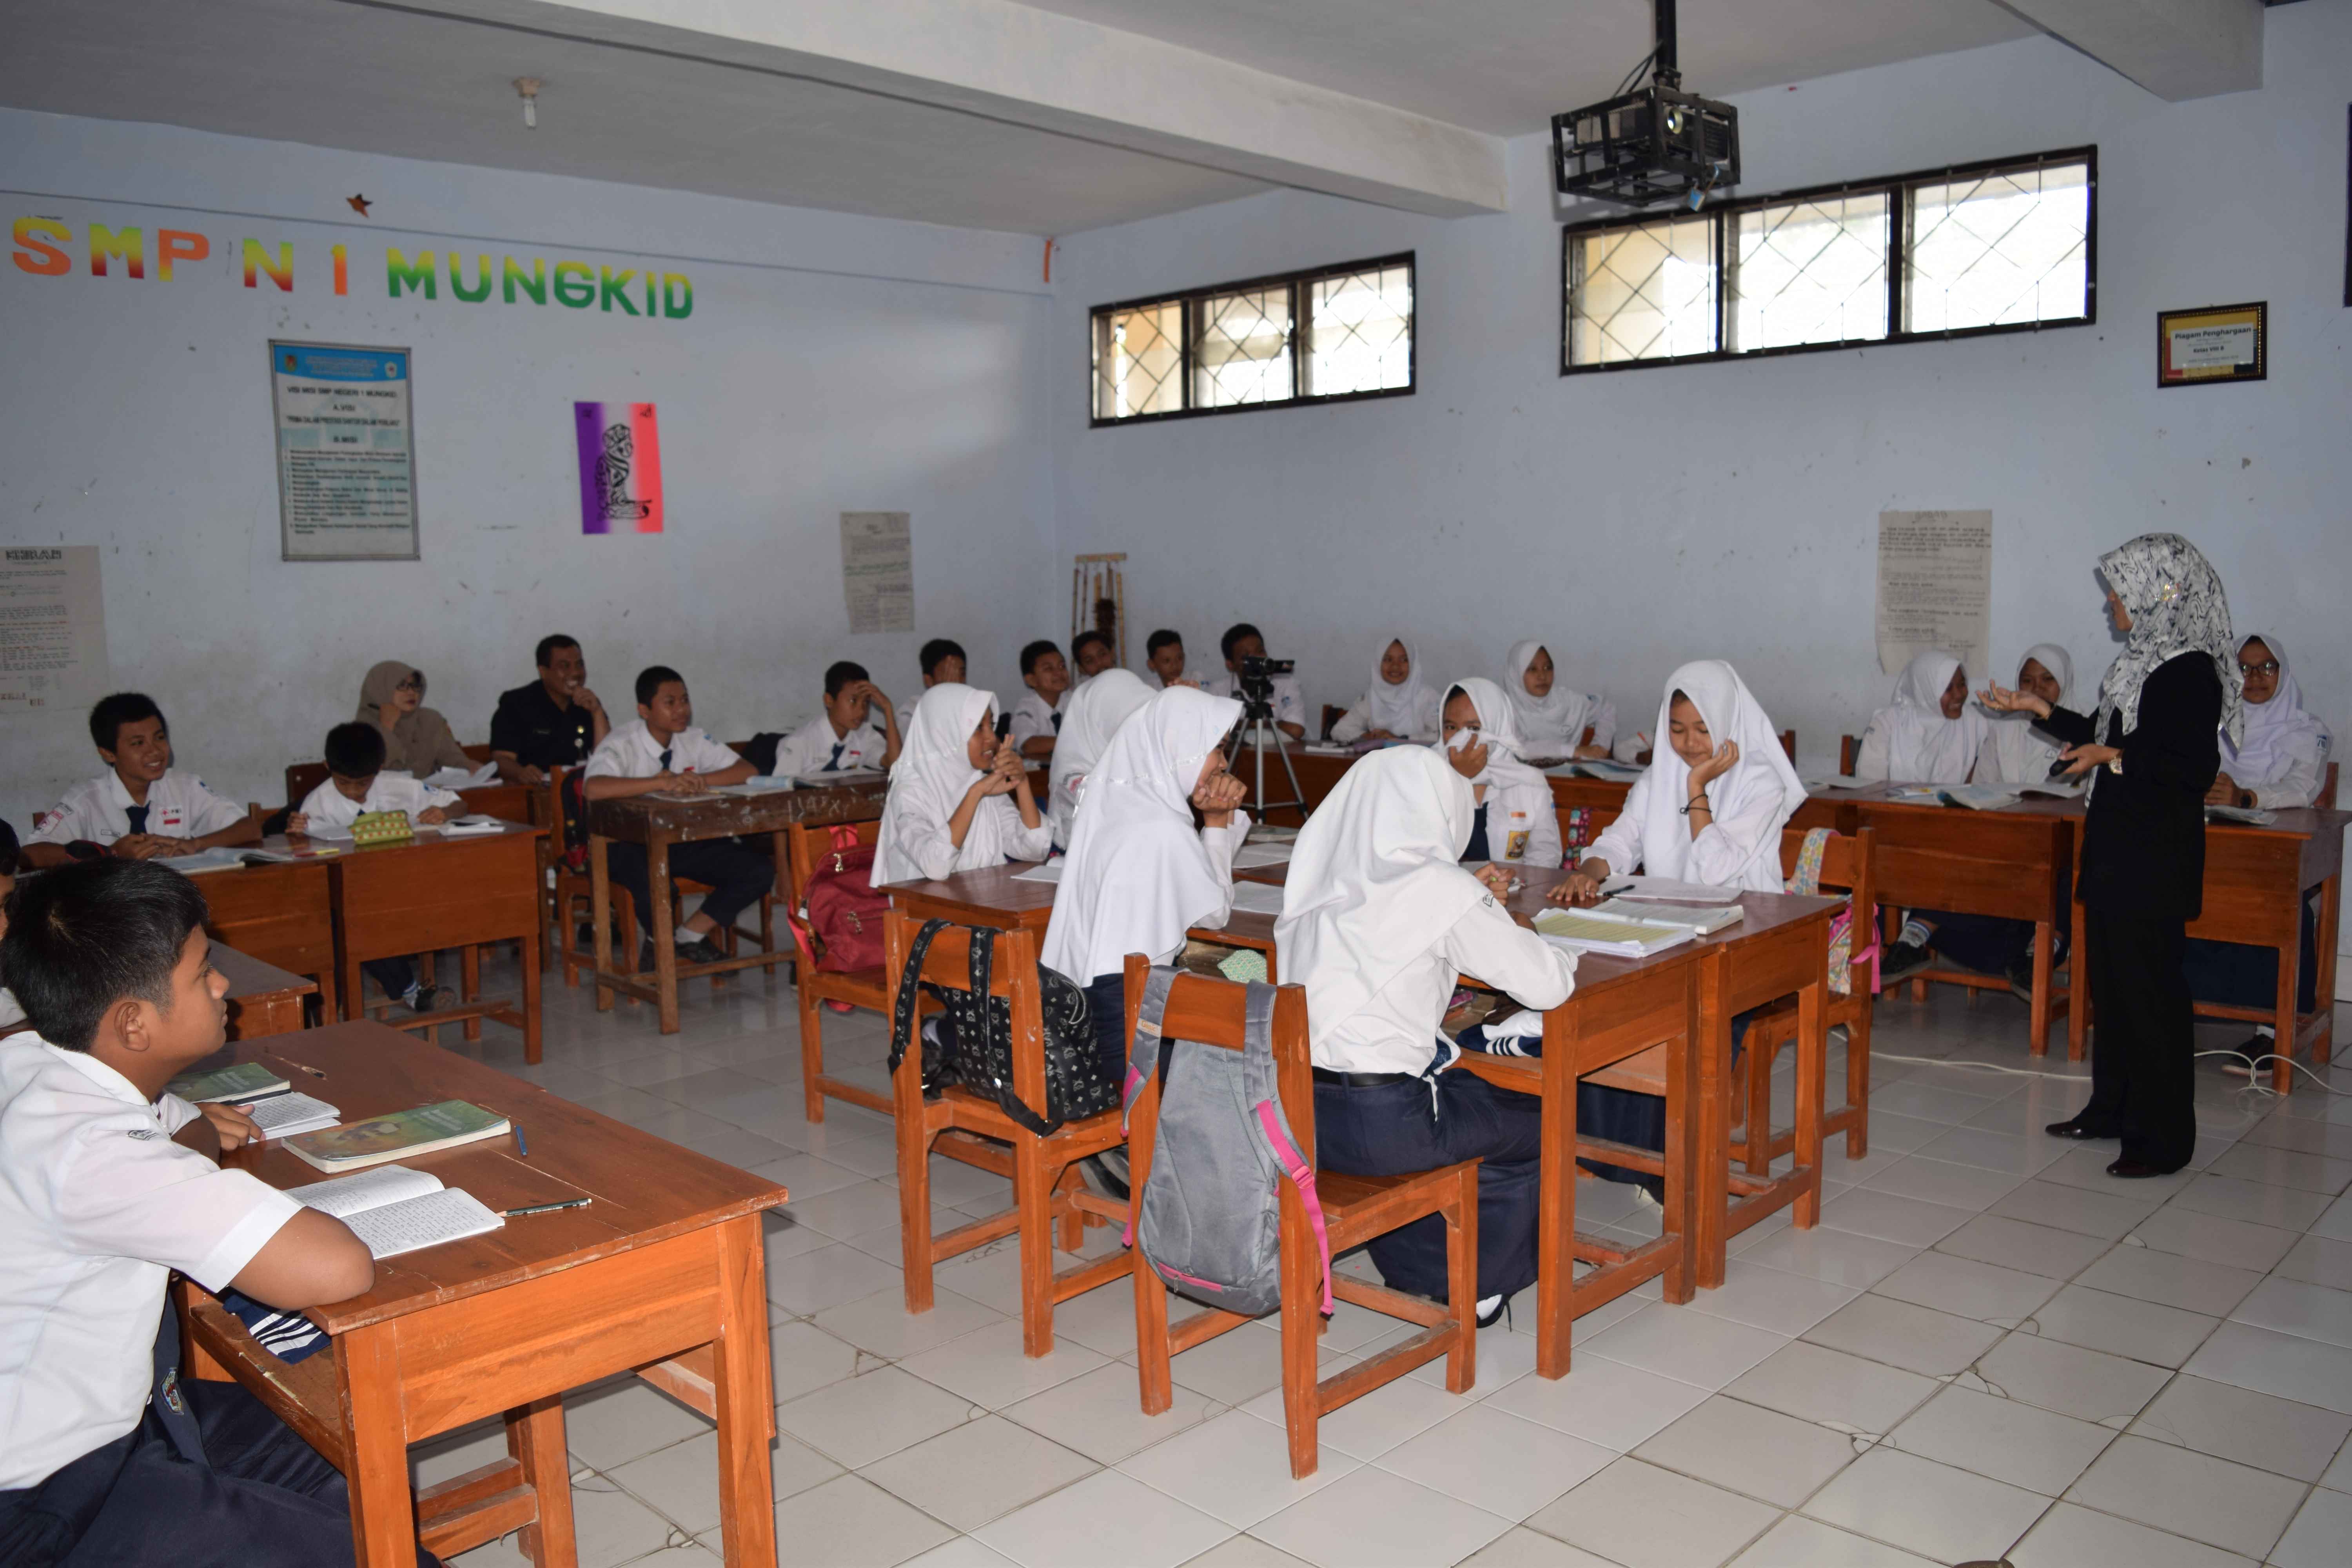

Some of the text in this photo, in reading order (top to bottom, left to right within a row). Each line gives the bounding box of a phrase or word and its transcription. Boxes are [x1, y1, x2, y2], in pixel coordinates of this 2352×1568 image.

[13, 217, 209, 281] SMP
[244, 239, 293, 292] N
[387, 248, 693, 319] MUNGKID
[2175, 327, 2251, 339] Piagam Penghargaan
